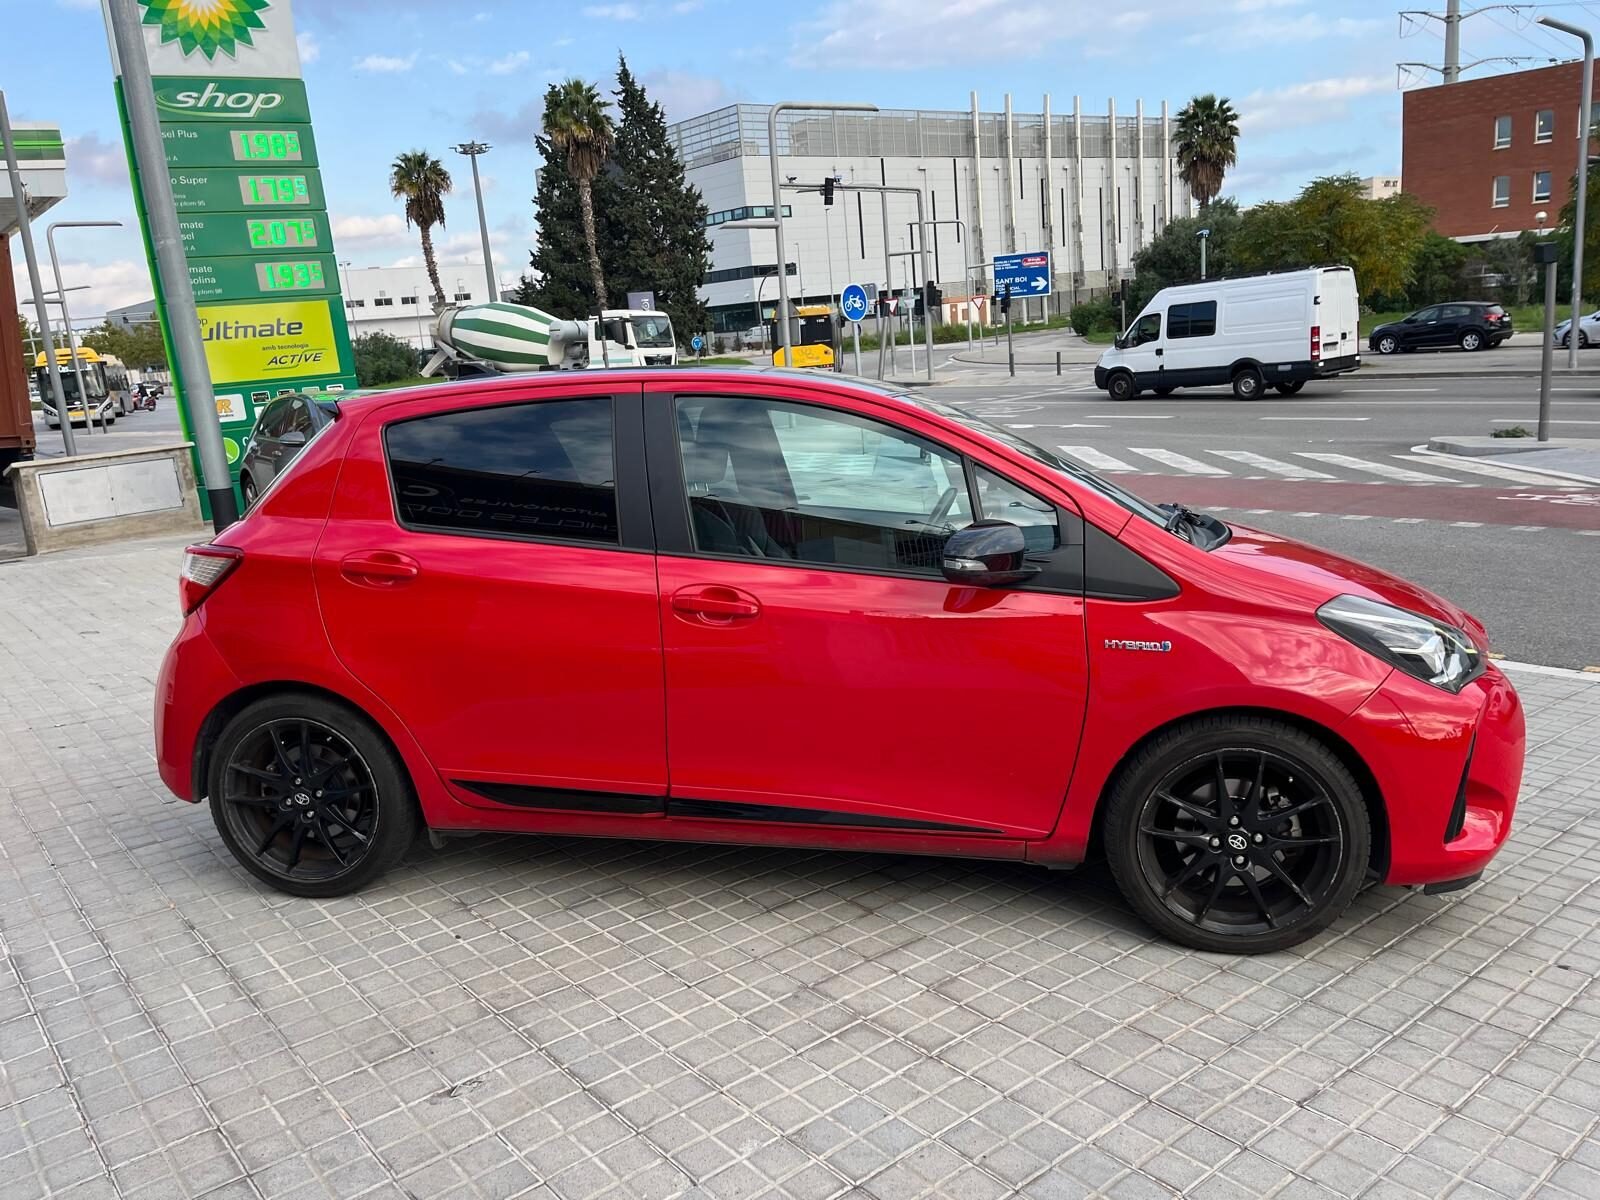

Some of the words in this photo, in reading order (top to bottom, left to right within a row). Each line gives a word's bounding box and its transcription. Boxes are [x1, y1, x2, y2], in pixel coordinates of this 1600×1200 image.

[176, 83, 282, 117] shop
[161, 131, 175, 139] sel
[177, 130, 199, 139] Plus
[180, 176, 208, 185] Super
[181, 221, 205, 229] mate
[181, 232, 195, 240] sel
[188, 265, 213, 273] mate
[200, 318, 303, 342] ultimate
[268, 352, 323, 367] ACTIVE
[1104, 639, 1162, 651] HYBRID
